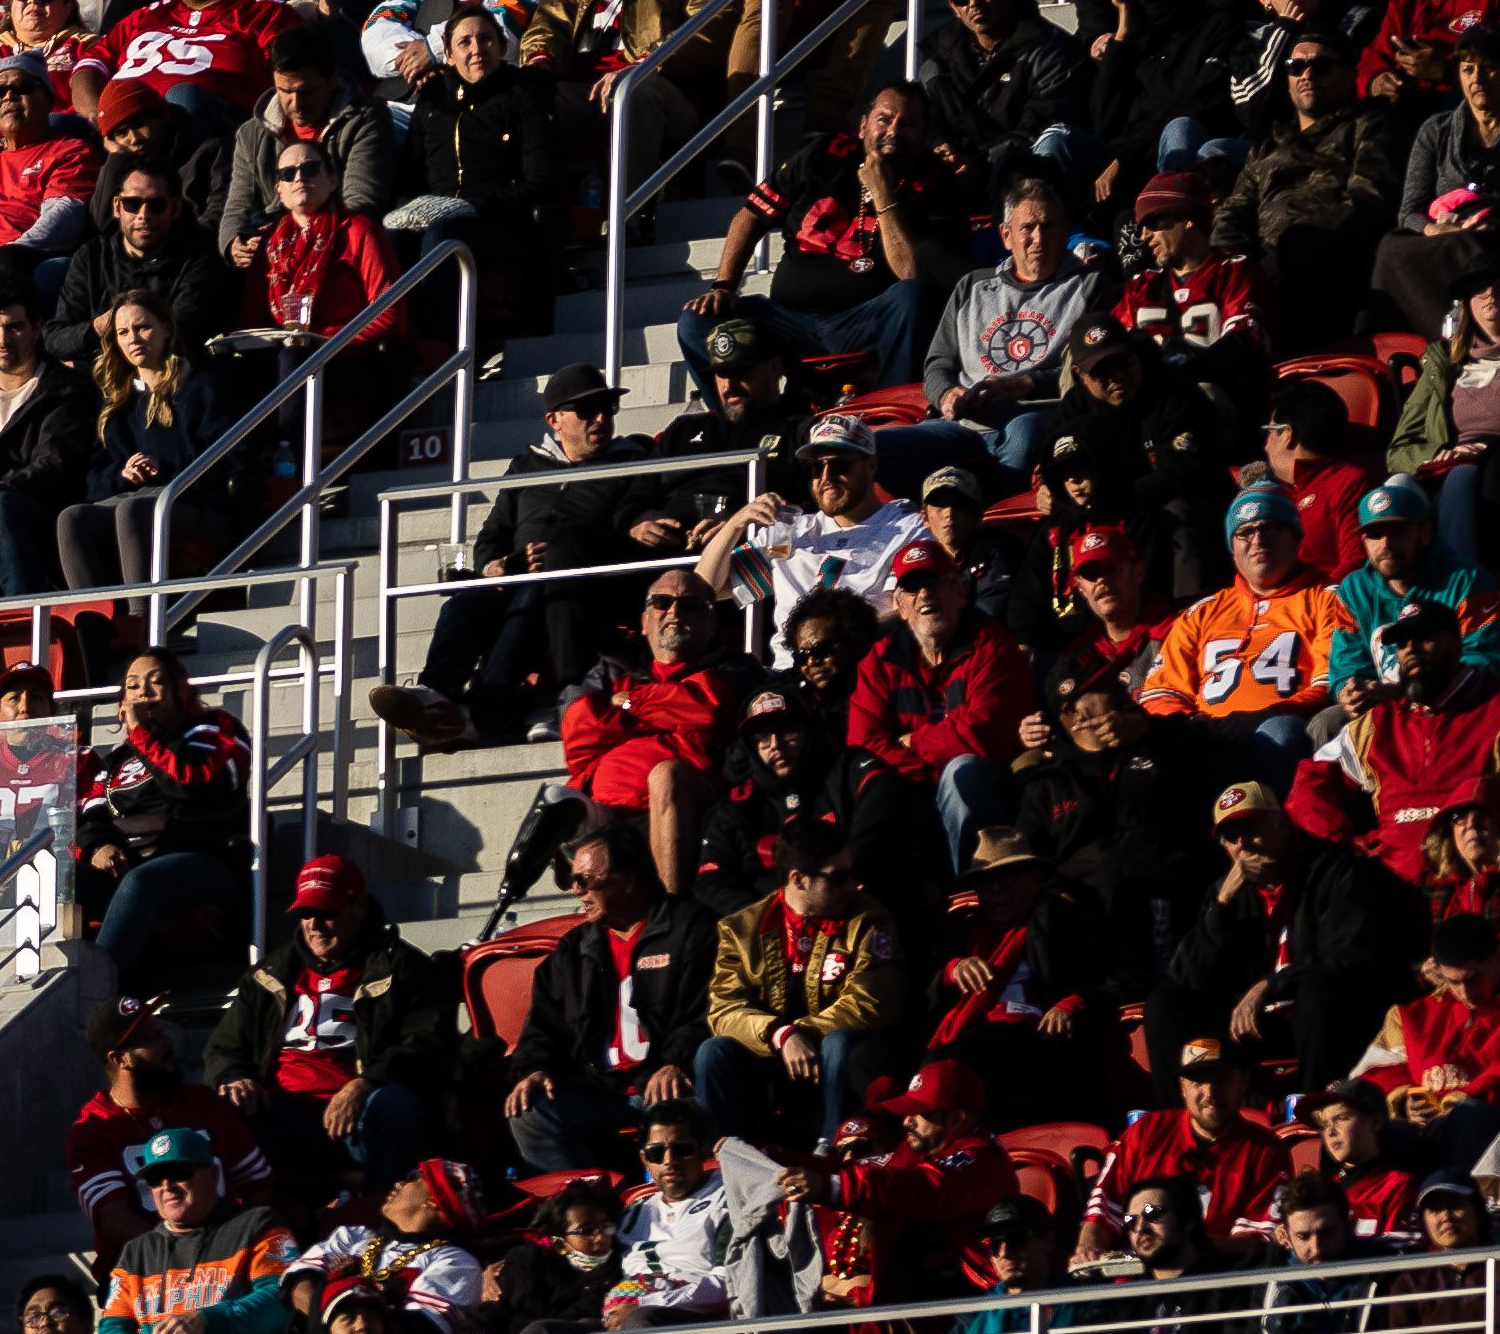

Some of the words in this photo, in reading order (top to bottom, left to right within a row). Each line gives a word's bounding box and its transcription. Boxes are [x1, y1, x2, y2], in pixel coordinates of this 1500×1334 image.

[111, 30, 216, 79] 85
[408, 435, 442, 461] 10
[1204, 633, 1298, 704] 54
